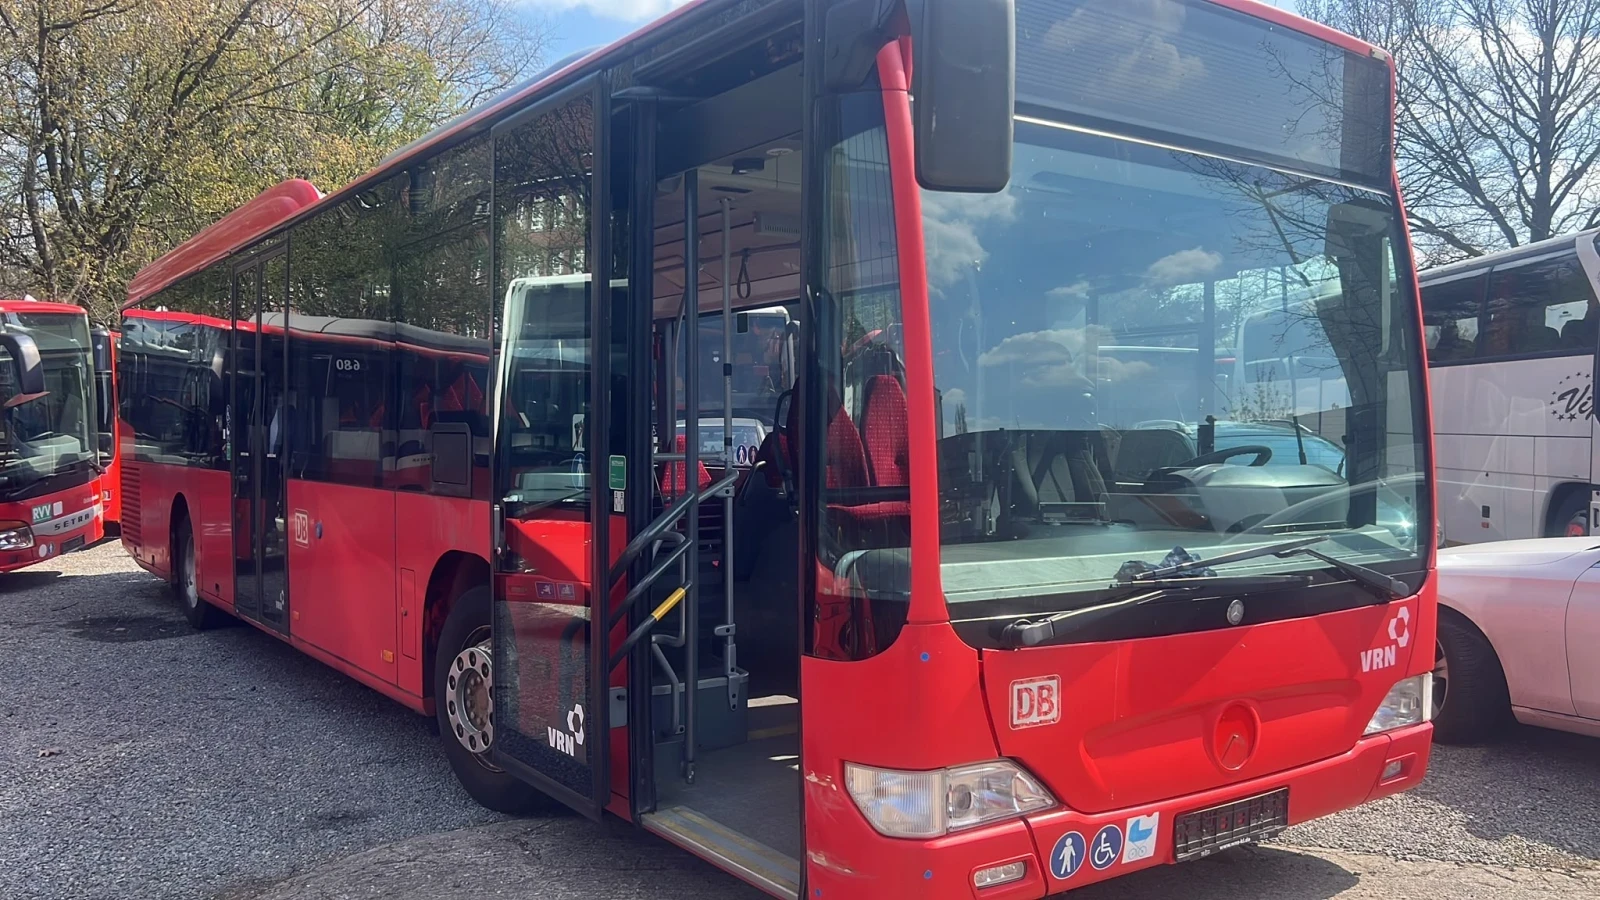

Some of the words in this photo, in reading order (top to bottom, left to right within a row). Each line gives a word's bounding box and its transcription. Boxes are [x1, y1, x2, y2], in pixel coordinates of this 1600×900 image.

[32, 503, 51, 520] RVV
[54, 513, 90, 531] SETRA
[295, 514, 308, 542] DB
[1360, 644, 1396, 673] VRN
[1016, 683, 1056, 721] DB
[547, 726, 575, 757] VRN
